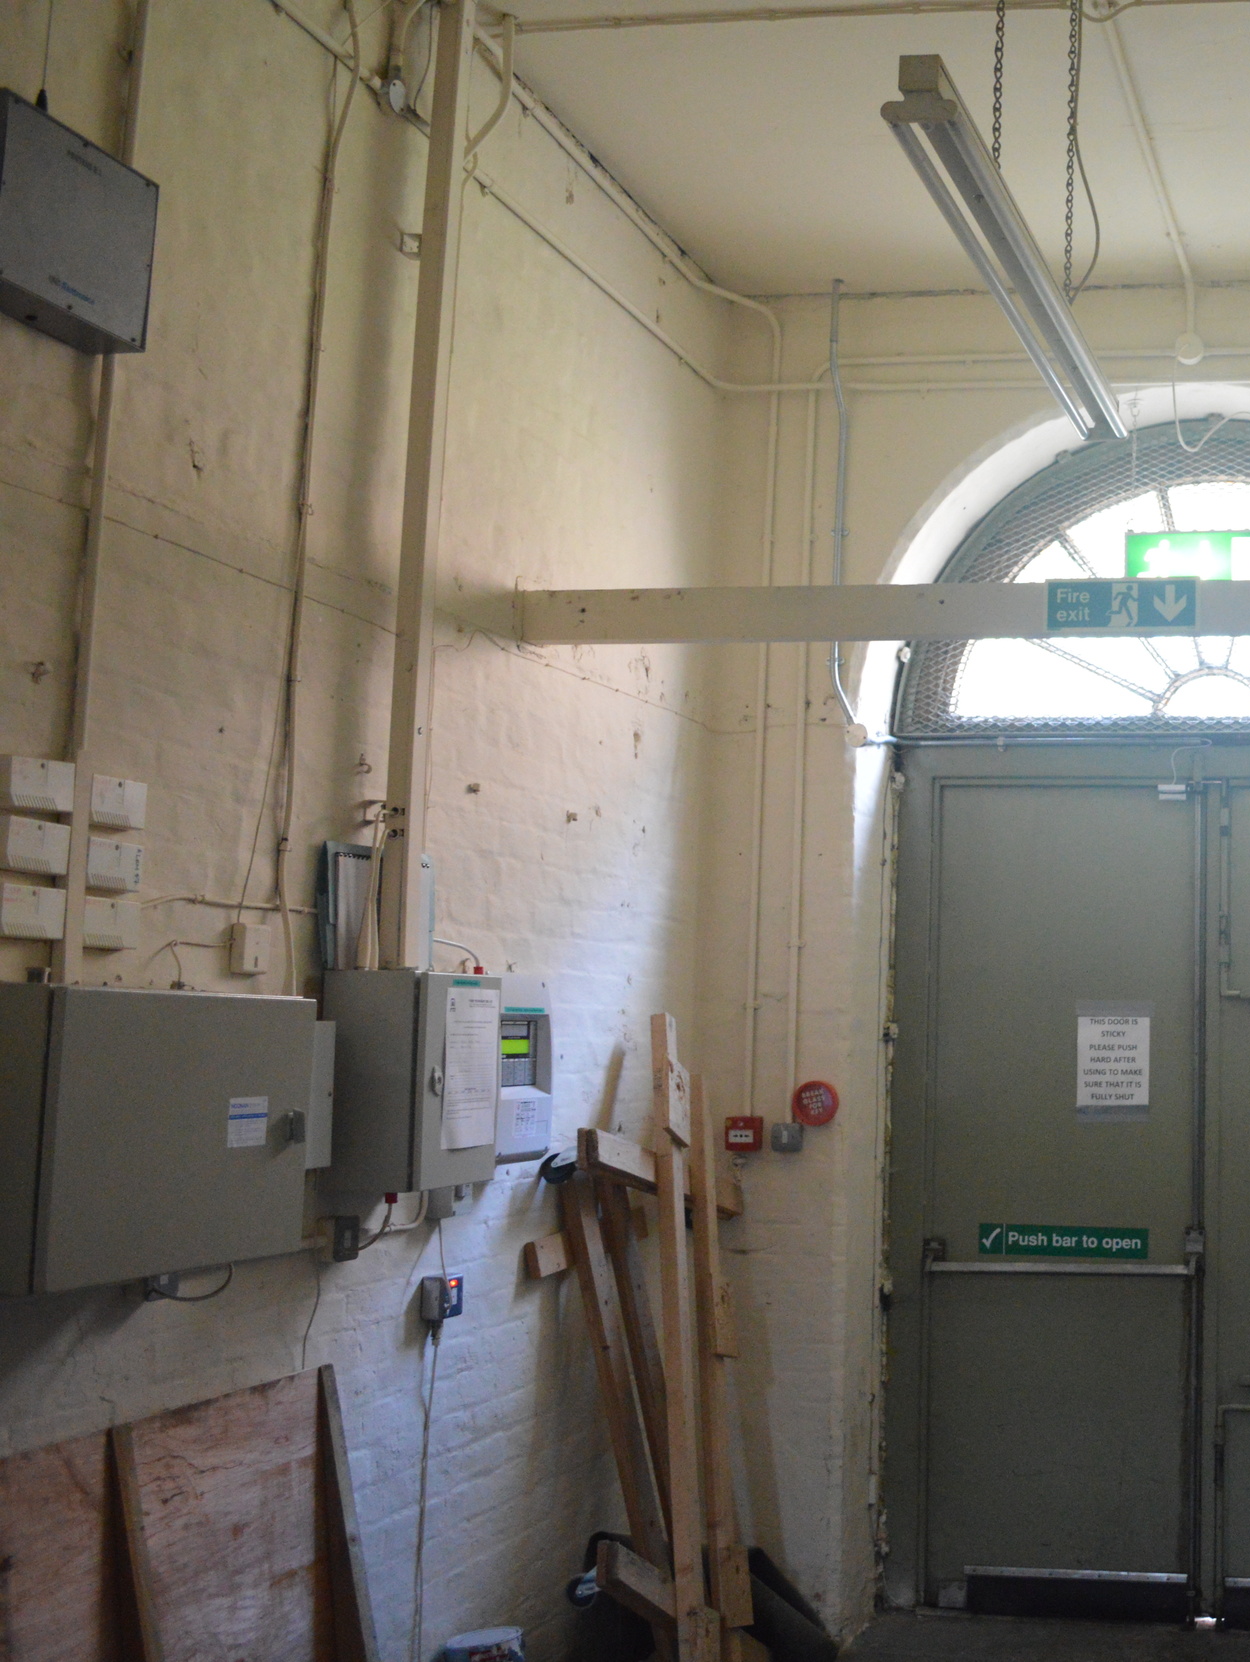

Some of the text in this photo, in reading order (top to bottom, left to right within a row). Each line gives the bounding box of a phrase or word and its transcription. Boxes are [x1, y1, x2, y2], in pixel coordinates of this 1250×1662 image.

[1056, 588, 1090, 603] Fire
[1056, 606, 1090, 622] exit
[1008, 1232, 1141, 1252] Push bar to open
